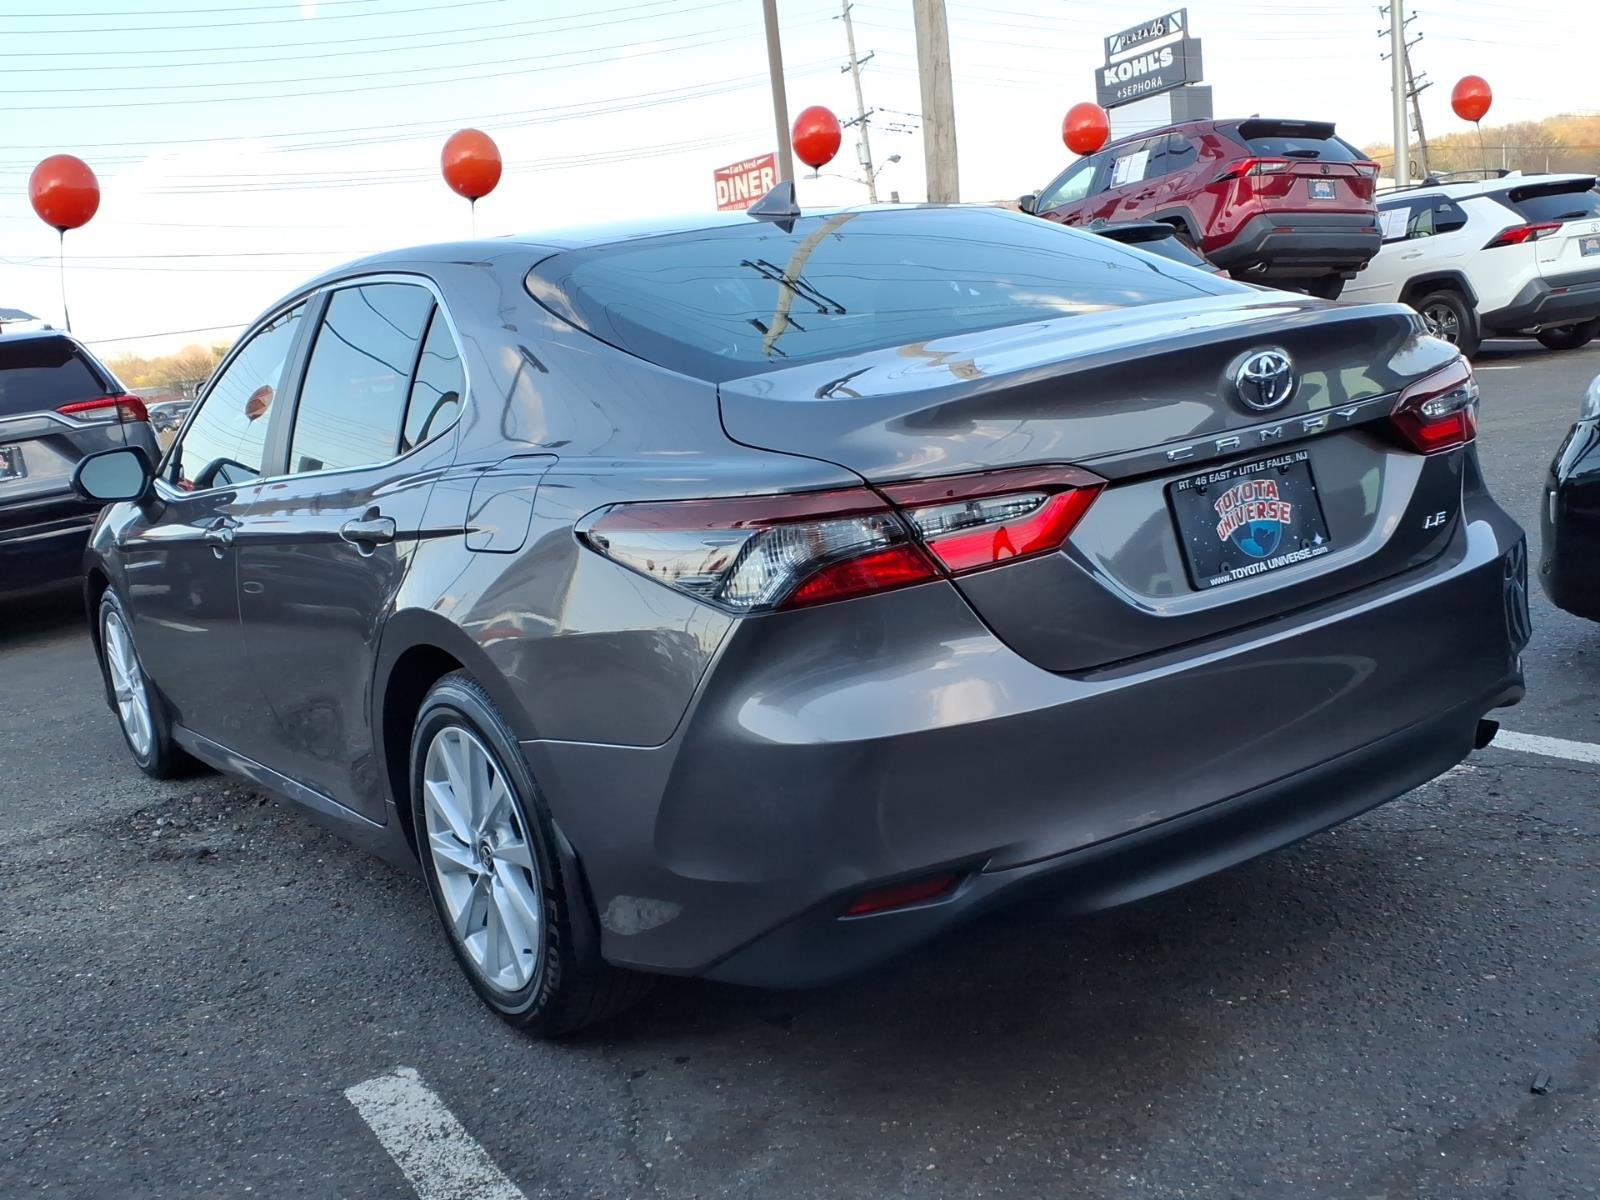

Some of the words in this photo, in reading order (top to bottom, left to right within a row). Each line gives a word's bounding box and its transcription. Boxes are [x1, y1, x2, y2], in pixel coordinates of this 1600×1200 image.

[1121, 29, 1149, 46] PLAZA
[1150, 18, 1164, 37] 46
[1104, 47, 1174, 86] KOHL'S
[716, 166, 775, 206] DINER
[1166, 407, 1359, 461] CAMRY
[1178, 480, 1193, 491] RT.
[1195, 476, 1207, 486] 46
[1209, 470, 1232, 483] EAST
[1239, 461, 1265, 476] LITTLE
[1266, 455, 1294, 469] FALLS,
[1295, 451, 1308, 461] NJ
[1214, 479, 1280, 518] TOYOTA
[1215, 500, 1292, 542] UNIVERSE
[1423, 510, 1447, 529] LE
